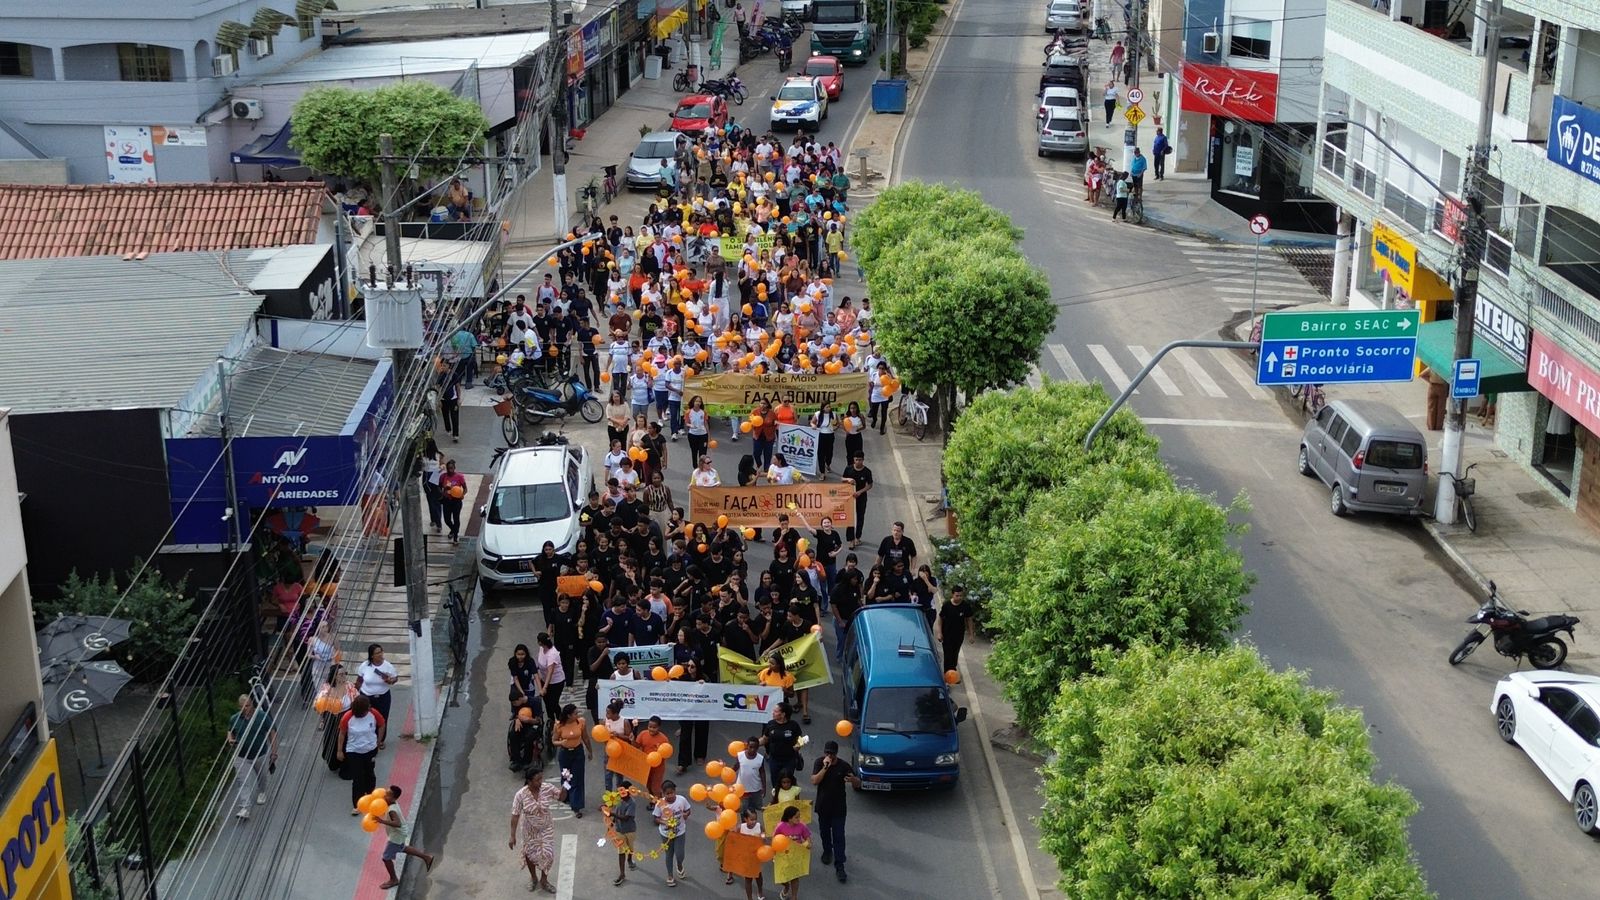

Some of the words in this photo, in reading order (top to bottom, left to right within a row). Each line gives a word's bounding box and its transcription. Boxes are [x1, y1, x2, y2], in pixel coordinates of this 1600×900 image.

[1130, 91, 1140, 99] 40
[1194, 77, 1263, 105] Rafik
[1301, 321, 1346, 332] Bairro
[1354, 320, 1390, 330] SEAC
[1474, 293, 1526, 351] ATEUS
[1302, 348, 1350, 358] Pronto
[1356, 346, 1410, 356] Socorro
[1300, 362, 1374, 374] Rodoviária
[1538, 351, 1572, 396] BOM
[787, 390, 836, 404] BONITO
[274, 448, 308, 468] AV
[781, 444, 814, 458] CRAS
[248, 472, 308, 484] ANTÔNIO
[268, 488, 338, 499] VARIEDADES
[724, 495, 758, 512] FAÇA
[776, 493, 822, 508] BONITO
[786, 658, 806, 670] NITO
[722, 692, 770, 710] SCFV
[0, 772, 60, 900] POTI
